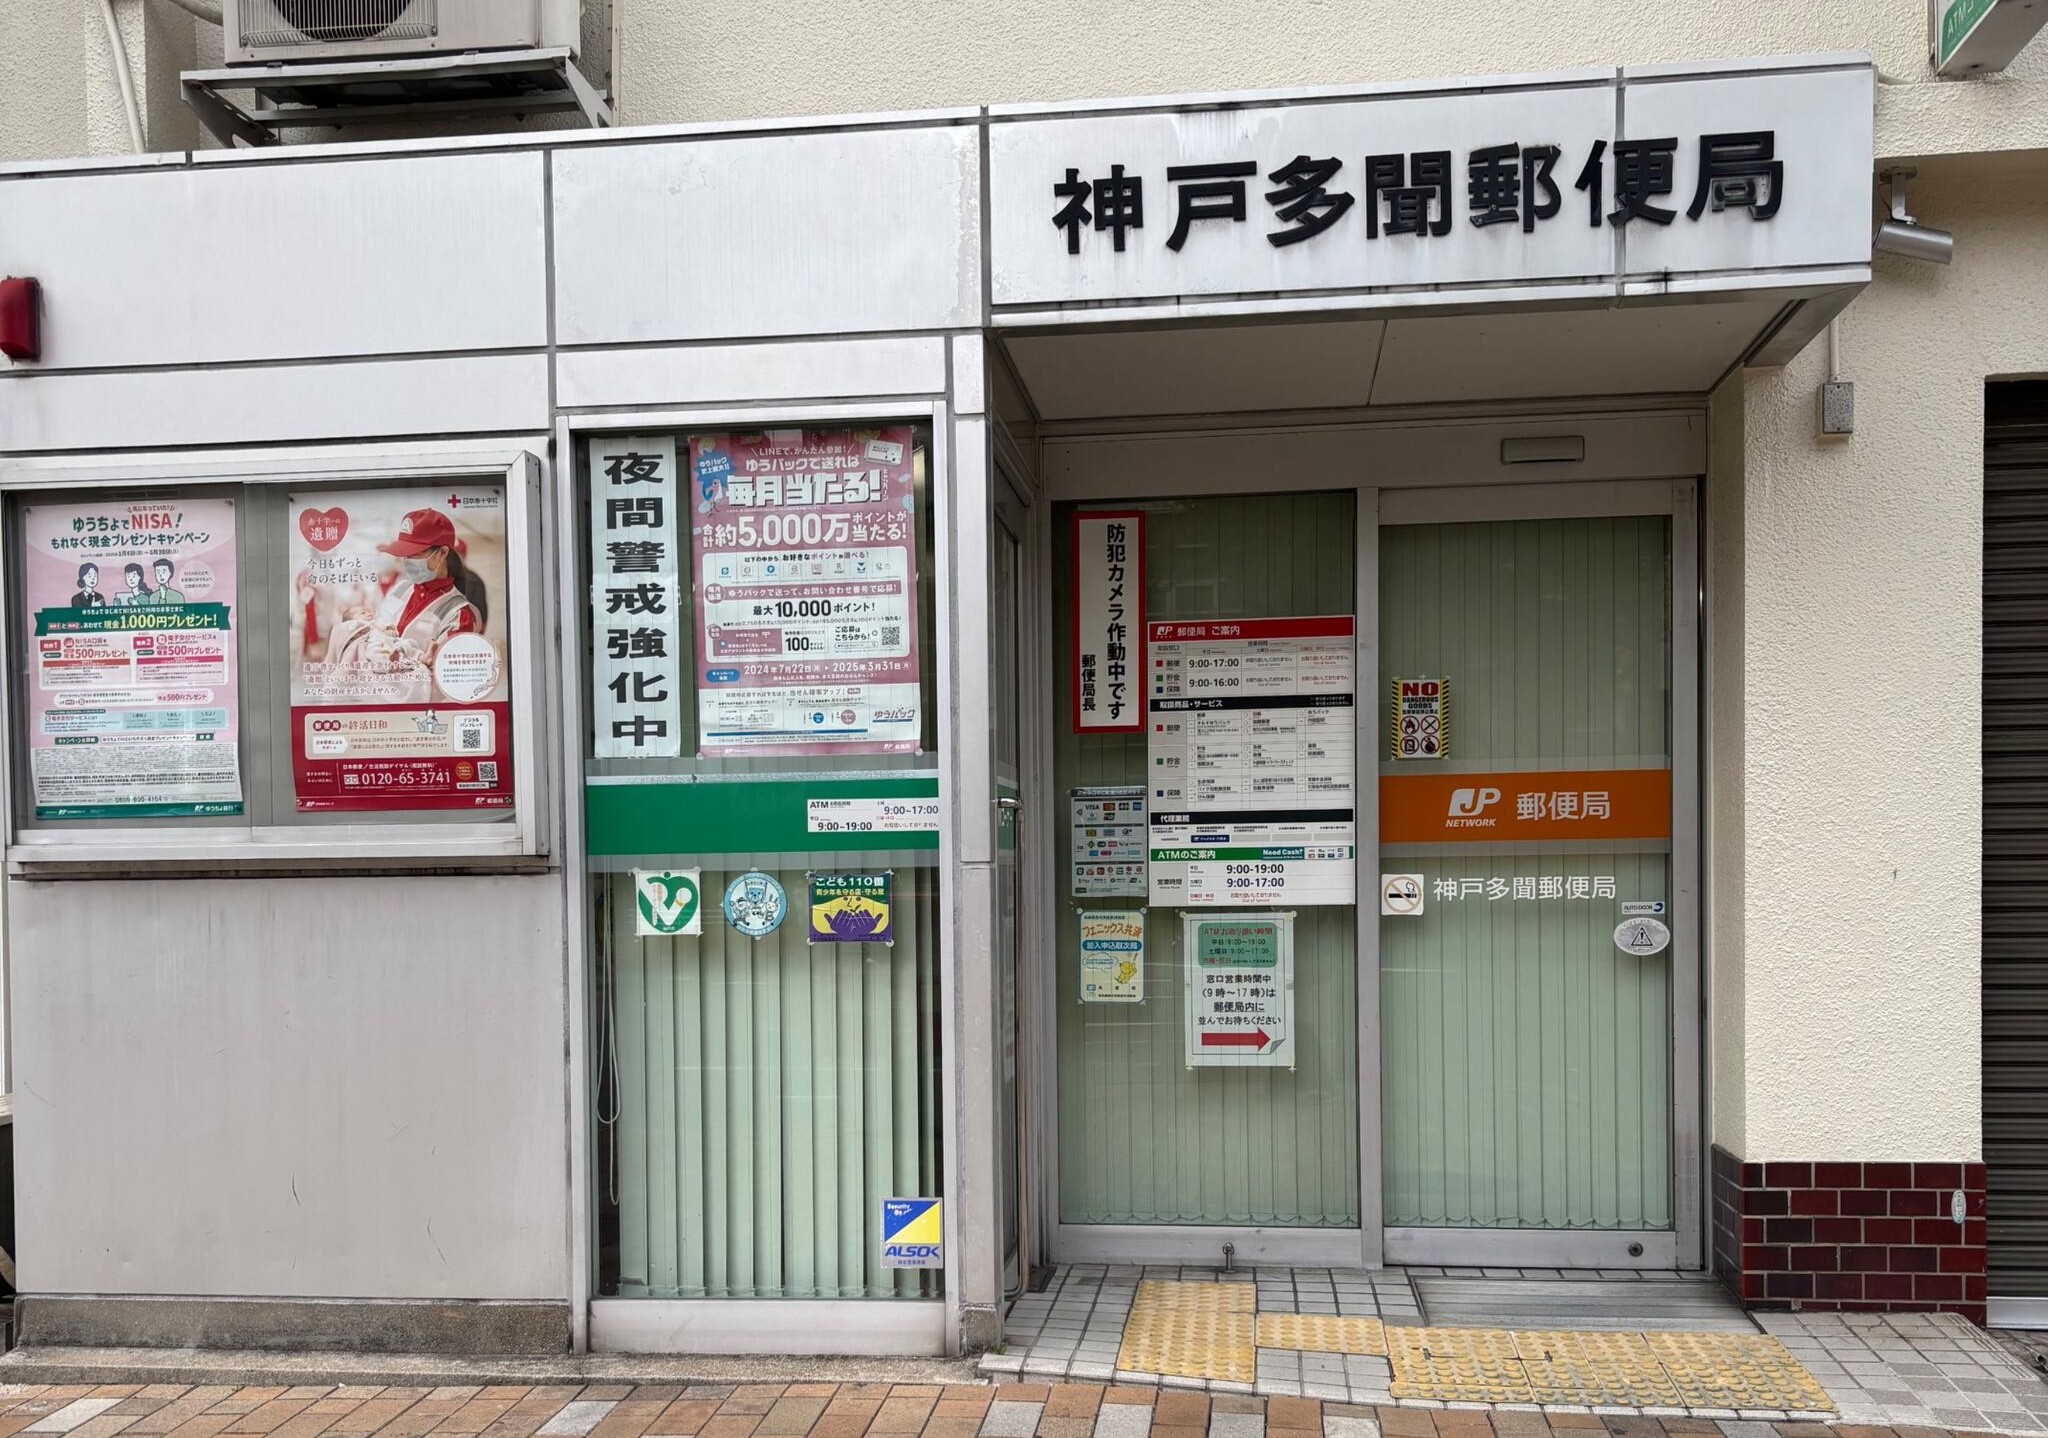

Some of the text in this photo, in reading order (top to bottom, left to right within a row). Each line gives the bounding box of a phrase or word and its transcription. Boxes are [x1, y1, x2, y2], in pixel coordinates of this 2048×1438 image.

[1052, 130, 1784, 254] 神戸多聞郵便局
[746, 456, 859, 472] ゆうパックで送れば
[726, 470, 882, 507] 毎月当たる!
[73, 512, 183, 532] ゆうちょでNISA!
[51, 532, 210, 549] もれなく現金プレゼントキャンペーン
[310, 527, 338, 541] 遺贈
[307, 557, 362, 569] 今日もずっと
[603, 452, 668, 747] 夜間警戒強化中
[753, 600, 876, 618] 最大10,000ポイント!
[1106, 523, 1127, 720] 防犯カメラ作動中です
[1211, 625, 1241, 636] ご案内
[784, 637, 810, 652] 100
[1188, 658, 1240, 669] 9:00-17:00
[1081, 653, 1097, 712] 郵便局長
[1188, 677, 1240, 688] 9:00-16:00
[1402, 682, 1439, 697] NO
[361, 772, 451, 785] 0120-65-3741
[809, 801, 829, 809] ATM
[884, 805, 939, 815] 9:00~17:00
[1448, 787, 1611, 821] JP 郵便局
[817, 822, 873, 831] 9:00~19:00
[1445, 818, 1497, 828] NETWORK
[1157, 849, 1216, 860] ATMのご案内
[1226, 863, 1284, 875] 9:00-19:00
[815, 876, 885, 887] こども110番
[1226, 877, 1285, 888] 9:00-17:00
[1433, 876, 1617, 901] 神戸多聞郵便局
[1206, 974, 1272, 984] 窓口営業時間中
[1213, 1001, 1265, 1013] 郵便局内に
[1198, 1016, 1282, 1025] 並んでお待ちください
[884, 1245, 940, 1259] ALSOK
